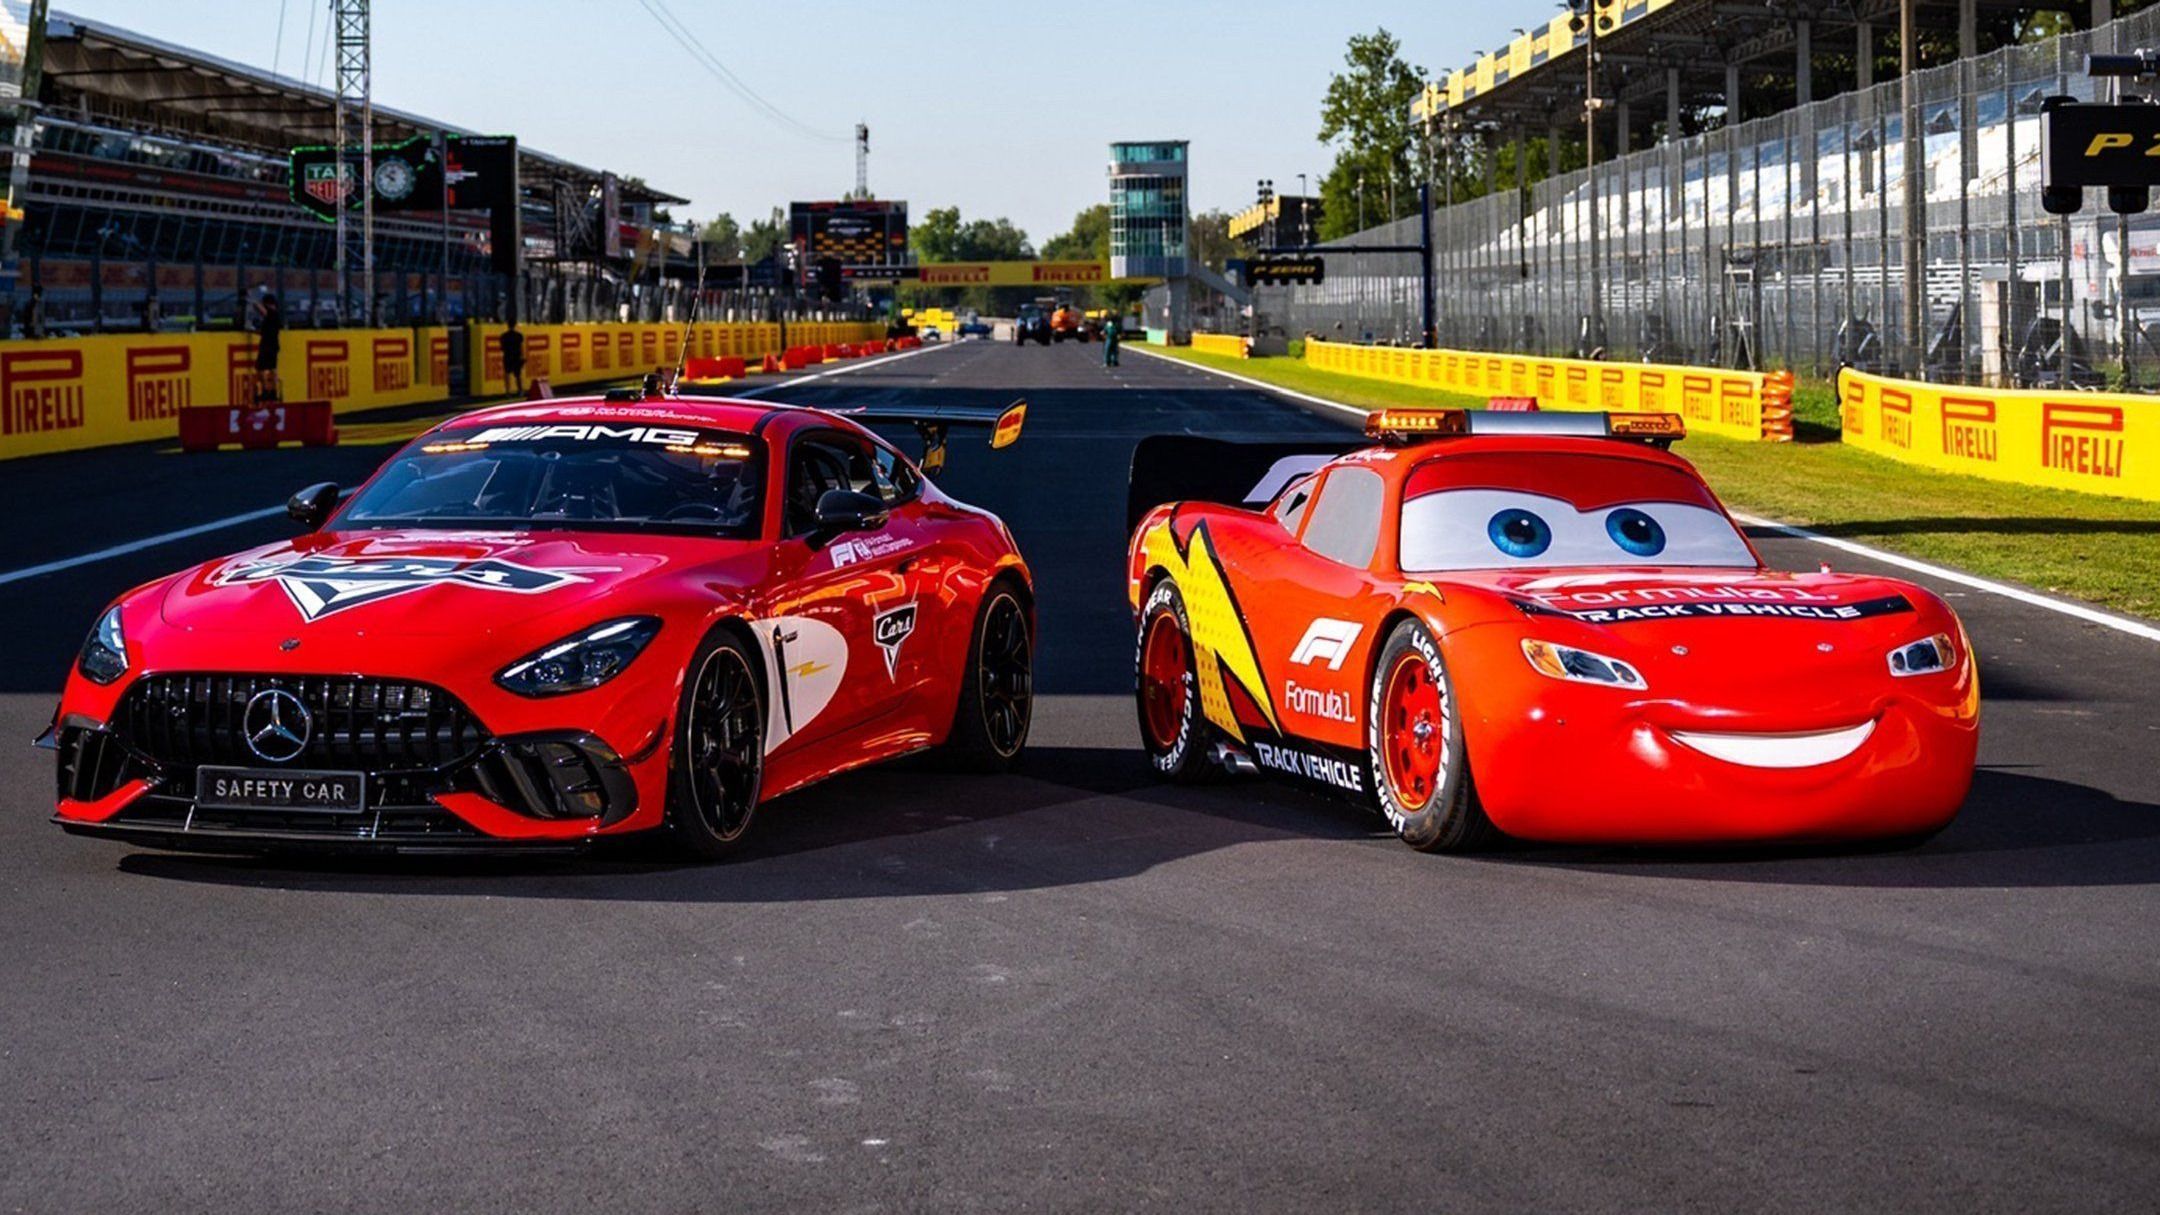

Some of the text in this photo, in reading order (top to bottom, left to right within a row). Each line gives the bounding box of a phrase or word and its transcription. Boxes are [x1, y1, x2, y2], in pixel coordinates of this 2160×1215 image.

[2084, 133, 2134, 157] P
[1, 349, 84, 435] PIRELLI
[127, 346, 191, 422] PIRELLI
[306, 340, 349, 400] PIRELLI
[538, 425, 699, 445] AMG
[1941, 397, 1997, 462] PIRELLI
[2042, 402, 2124, 478] PIRELLI
[878, 616, 911, 640] Cars
[1571, 604, 1861, 622] TRACK VEHICLE
[216, 779, 345, 800] SAFETY CAR
[1254, 742, 1363, 792] TRACK VEHICLE
